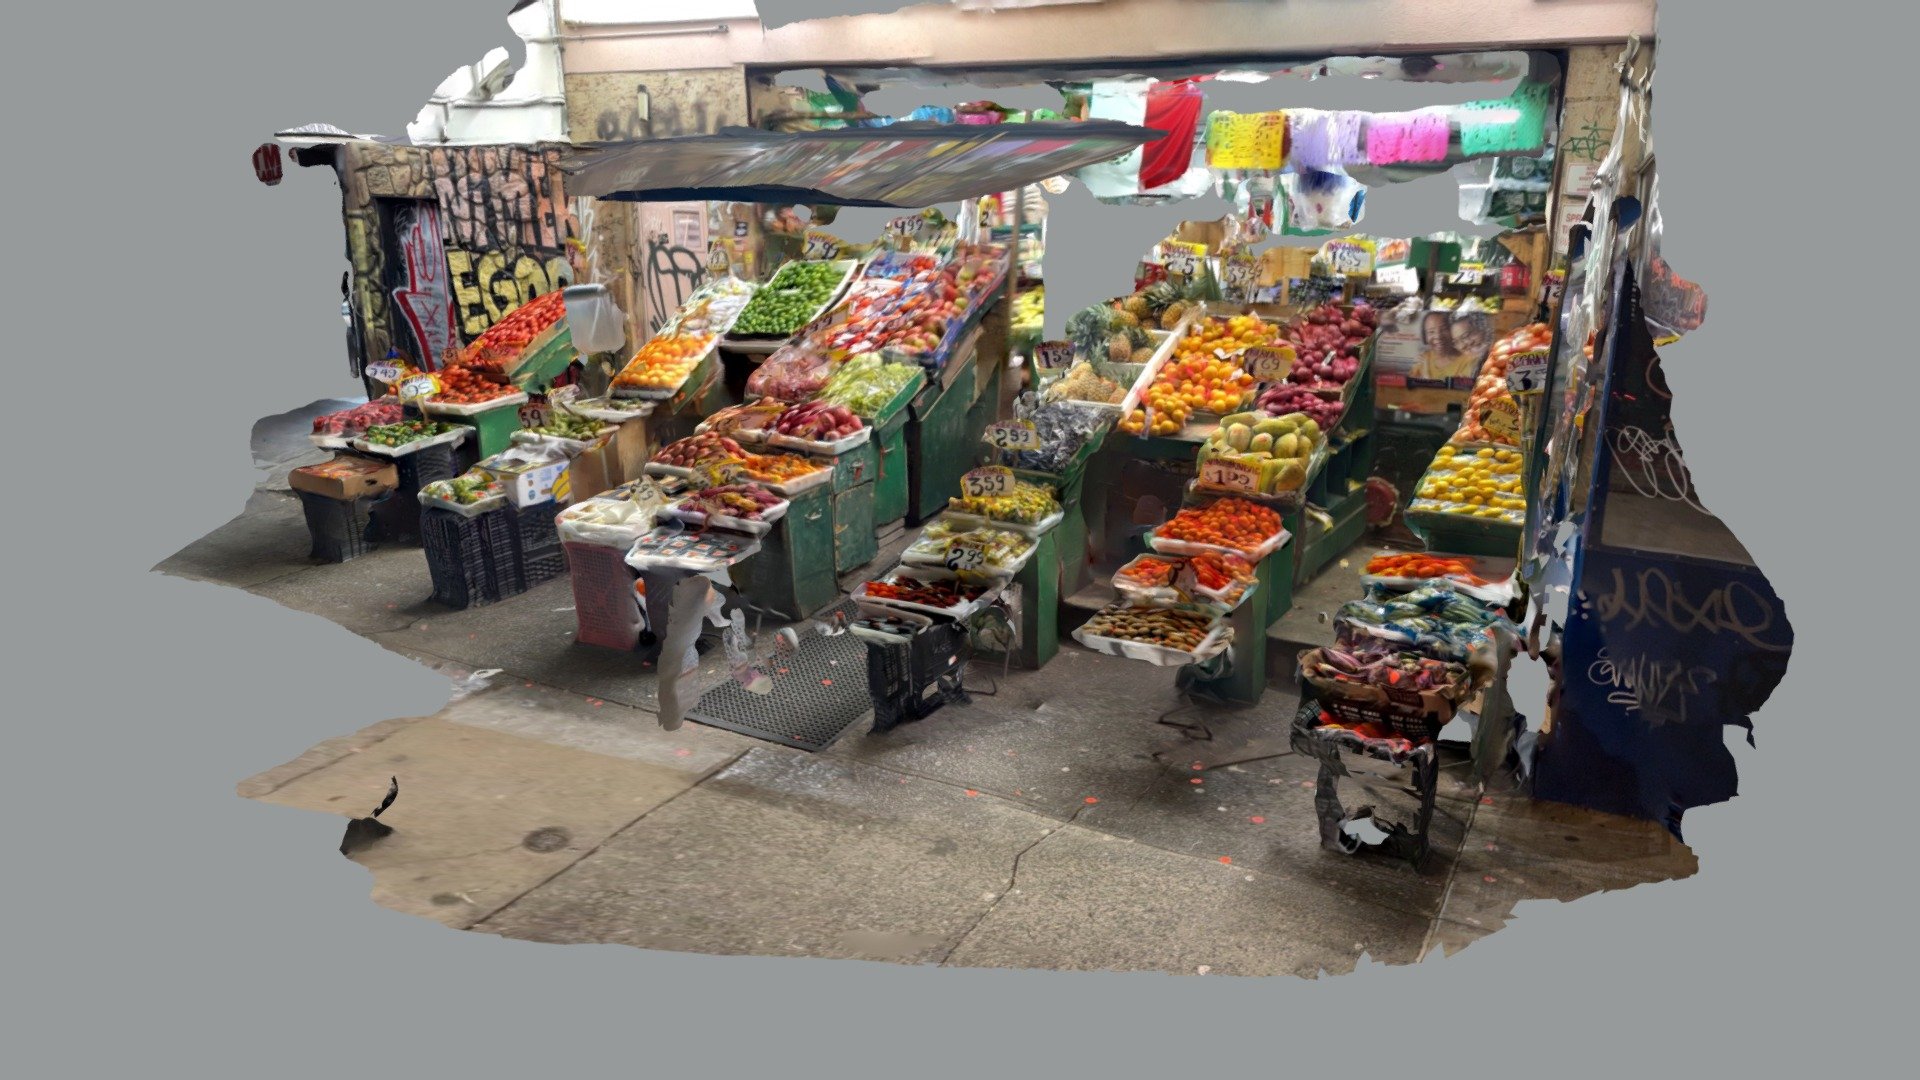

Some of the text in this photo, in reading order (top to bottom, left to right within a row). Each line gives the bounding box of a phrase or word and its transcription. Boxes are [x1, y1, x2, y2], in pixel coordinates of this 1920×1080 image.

[995, 428, 1029, 447] 299
[968, 475, 1005, 497] 359
[946, 549, 984, 570] 299
